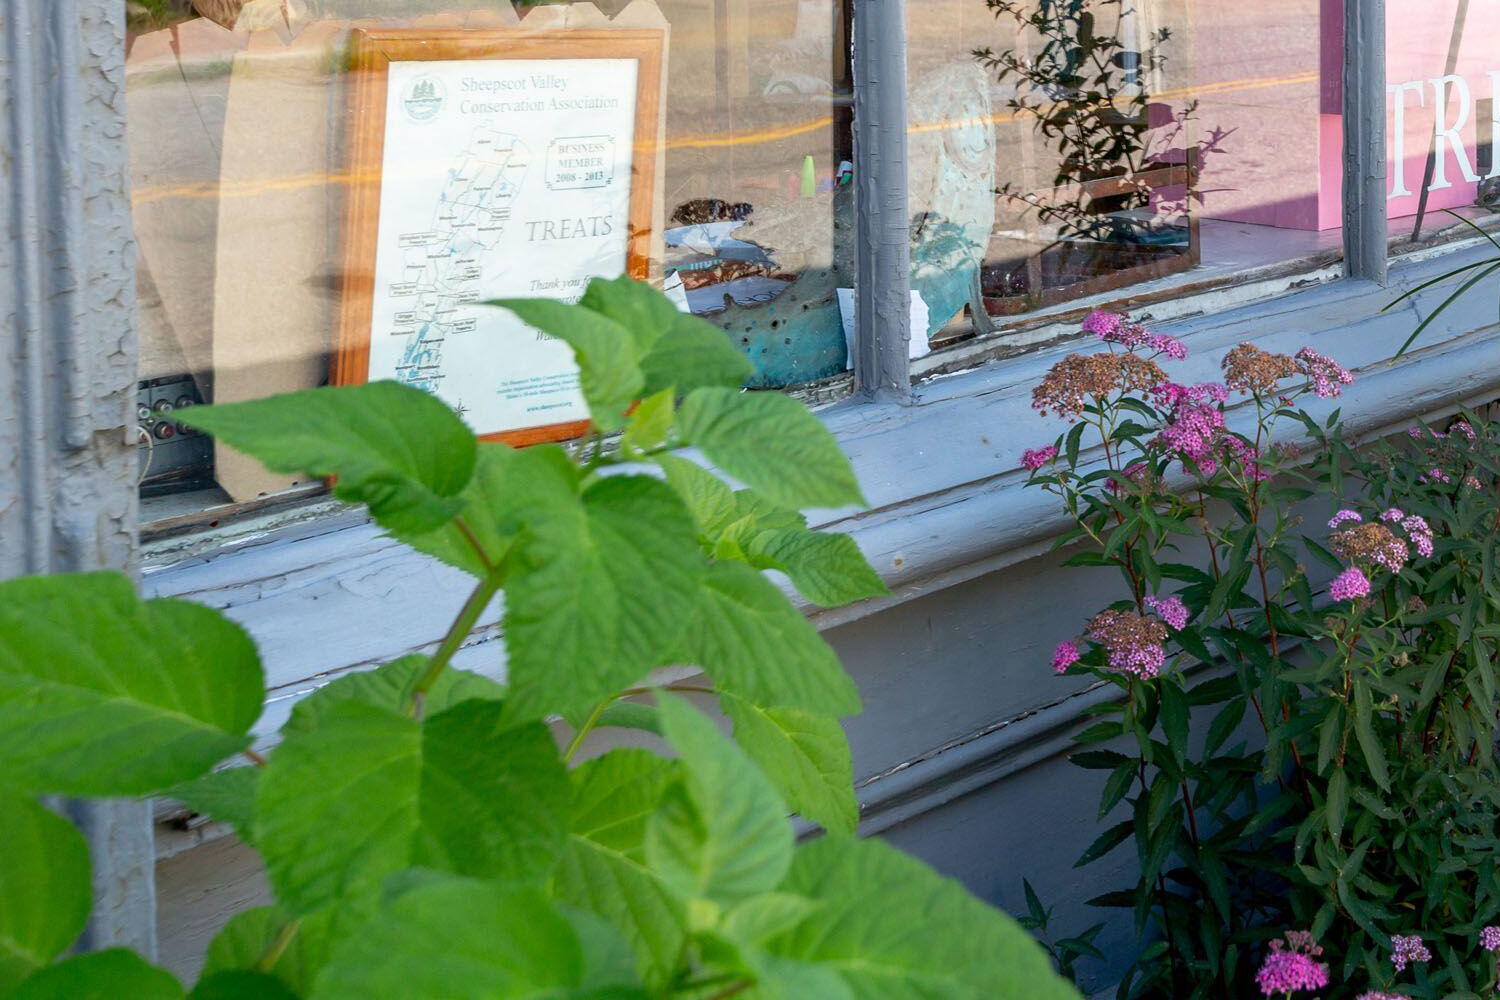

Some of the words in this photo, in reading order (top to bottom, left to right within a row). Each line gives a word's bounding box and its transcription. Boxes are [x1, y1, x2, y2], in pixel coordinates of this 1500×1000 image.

[461, 77, 526, 94] Sheepscot
[529, 75, 568, 92] Valley
[460, 99, 545, 114] Conservation
[548, 96, 619, 111] Association
[558, 143, 606, 154] BUSINESS
[558, 158, 603, 168] MEMBER
[526, 215, 613, 242] TREATS
[529, 277, 559, 292] Thank
[559, 279, 580, 291] you
